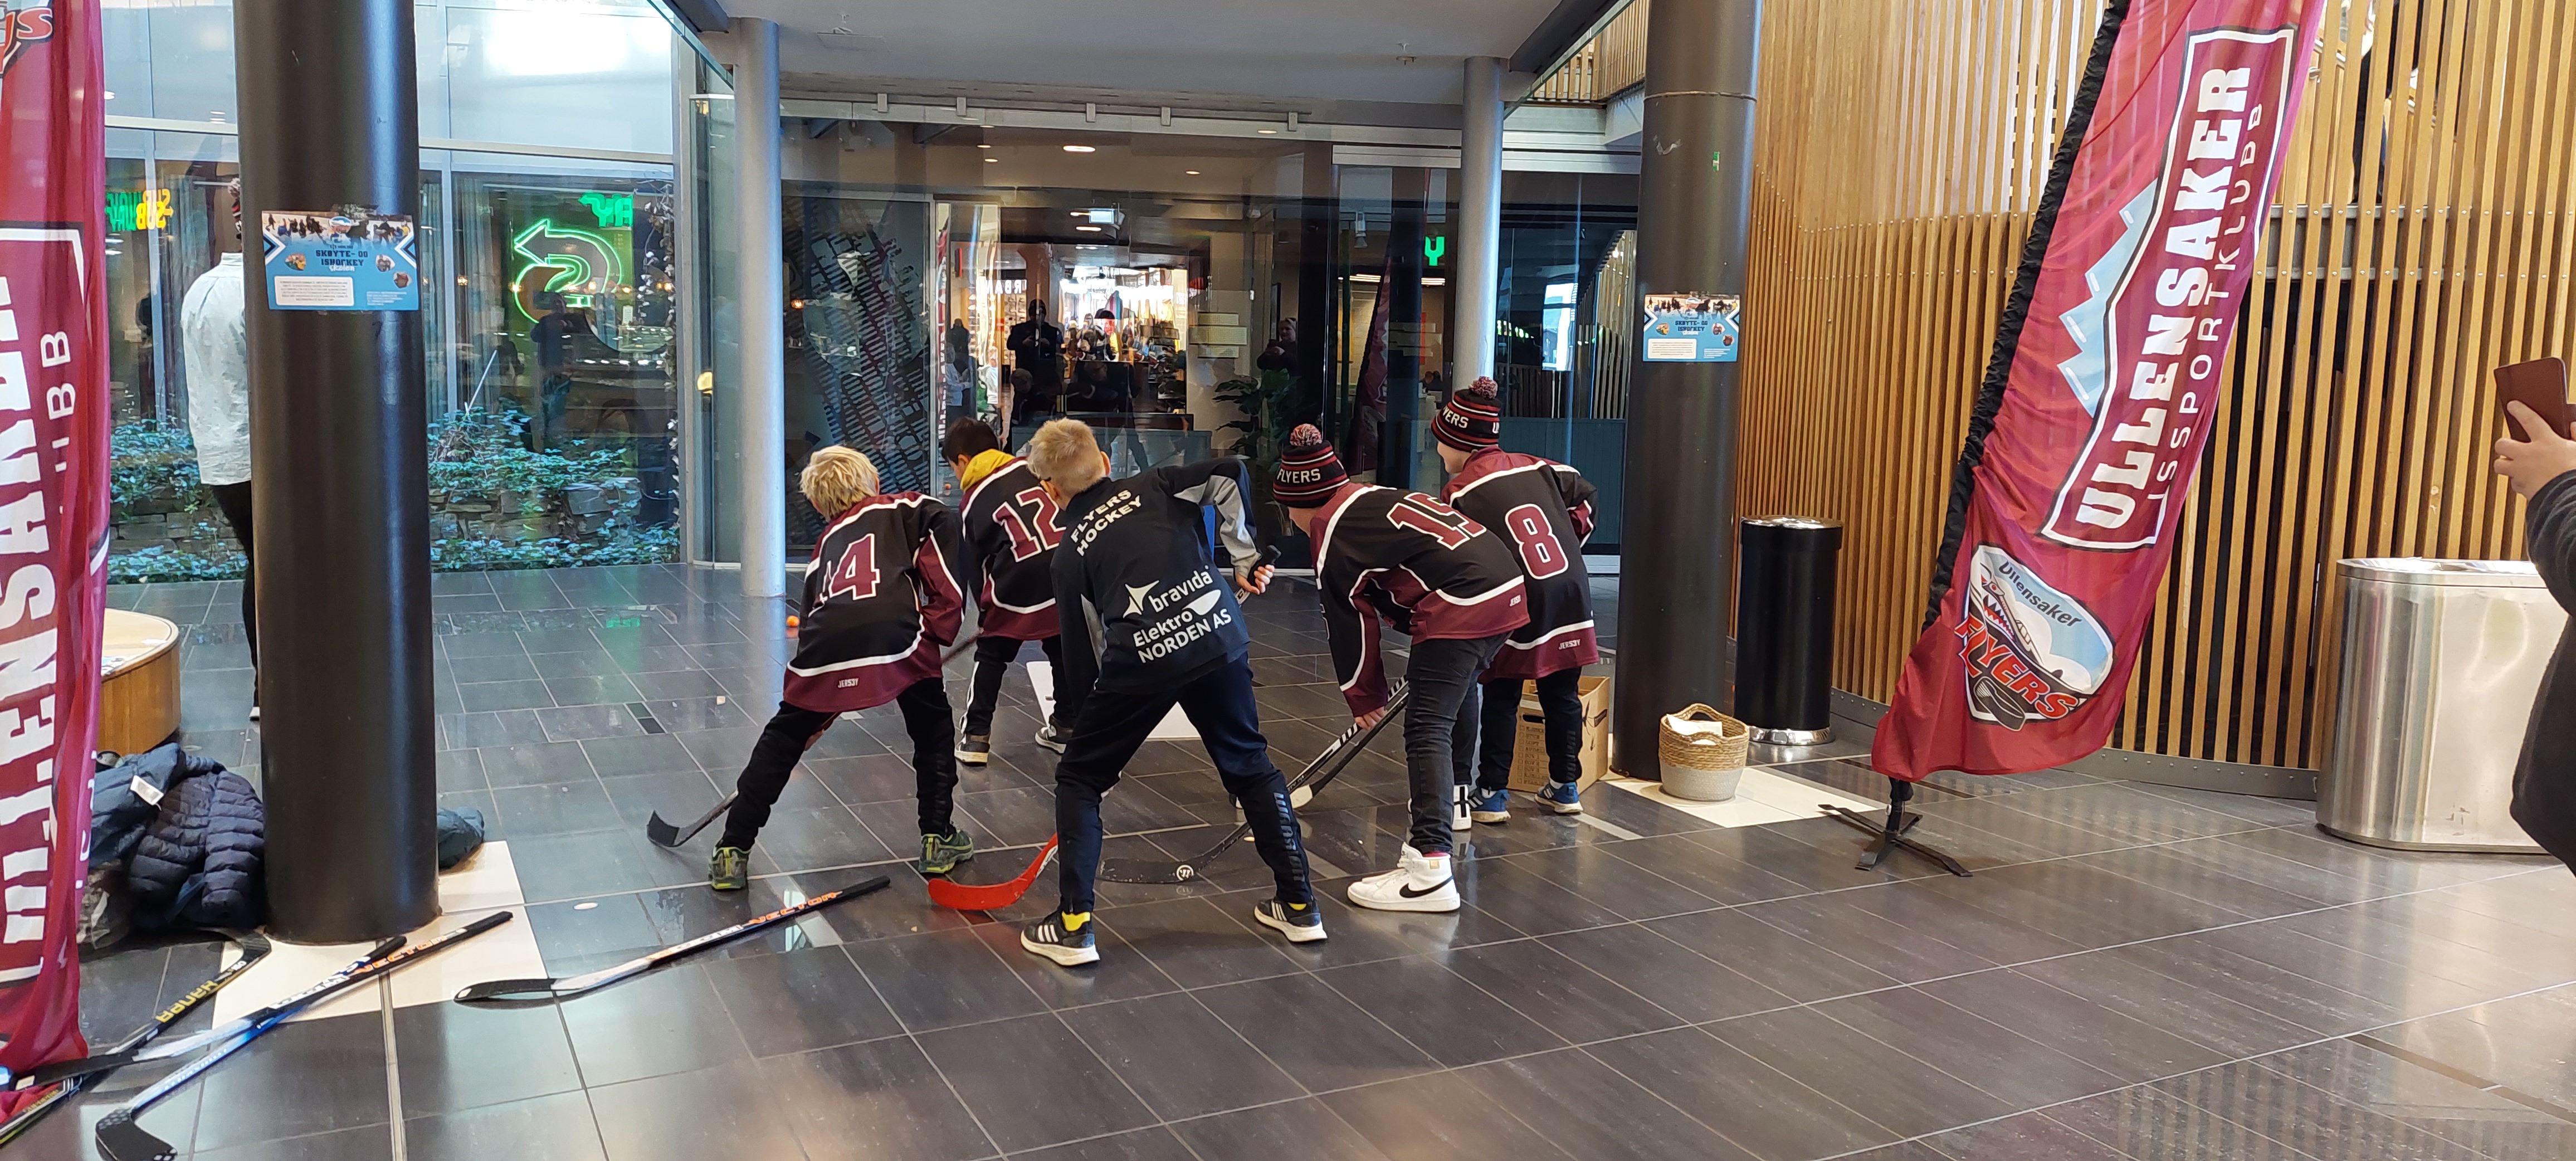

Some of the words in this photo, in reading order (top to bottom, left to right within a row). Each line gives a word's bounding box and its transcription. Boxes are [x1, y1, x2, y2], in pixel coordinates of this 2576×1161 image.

[2075, 67, 2251, 528] ULLENSAKER
[1277, 468, 1321, 484] FLYERS
[993, 486, 1067, 562] 12
[1070, 490, 1132, 543] FLYERS
[1076, 495, 1141, 556] HOCKEY
[1505, 504, 1569, 579] 8
[1149, 568, 1213, 613] bravida
[1998, 562, 2082, 627] Ullensaker
[1133, 611, 1193, 647] Elektro
[1138, 619, 1212, 664] NORDEN
[1213, 609, 1232, 628] AS
[1955, 617, 2078, 719] FLYERS
[747, 891, 840, 925] VECTOR
